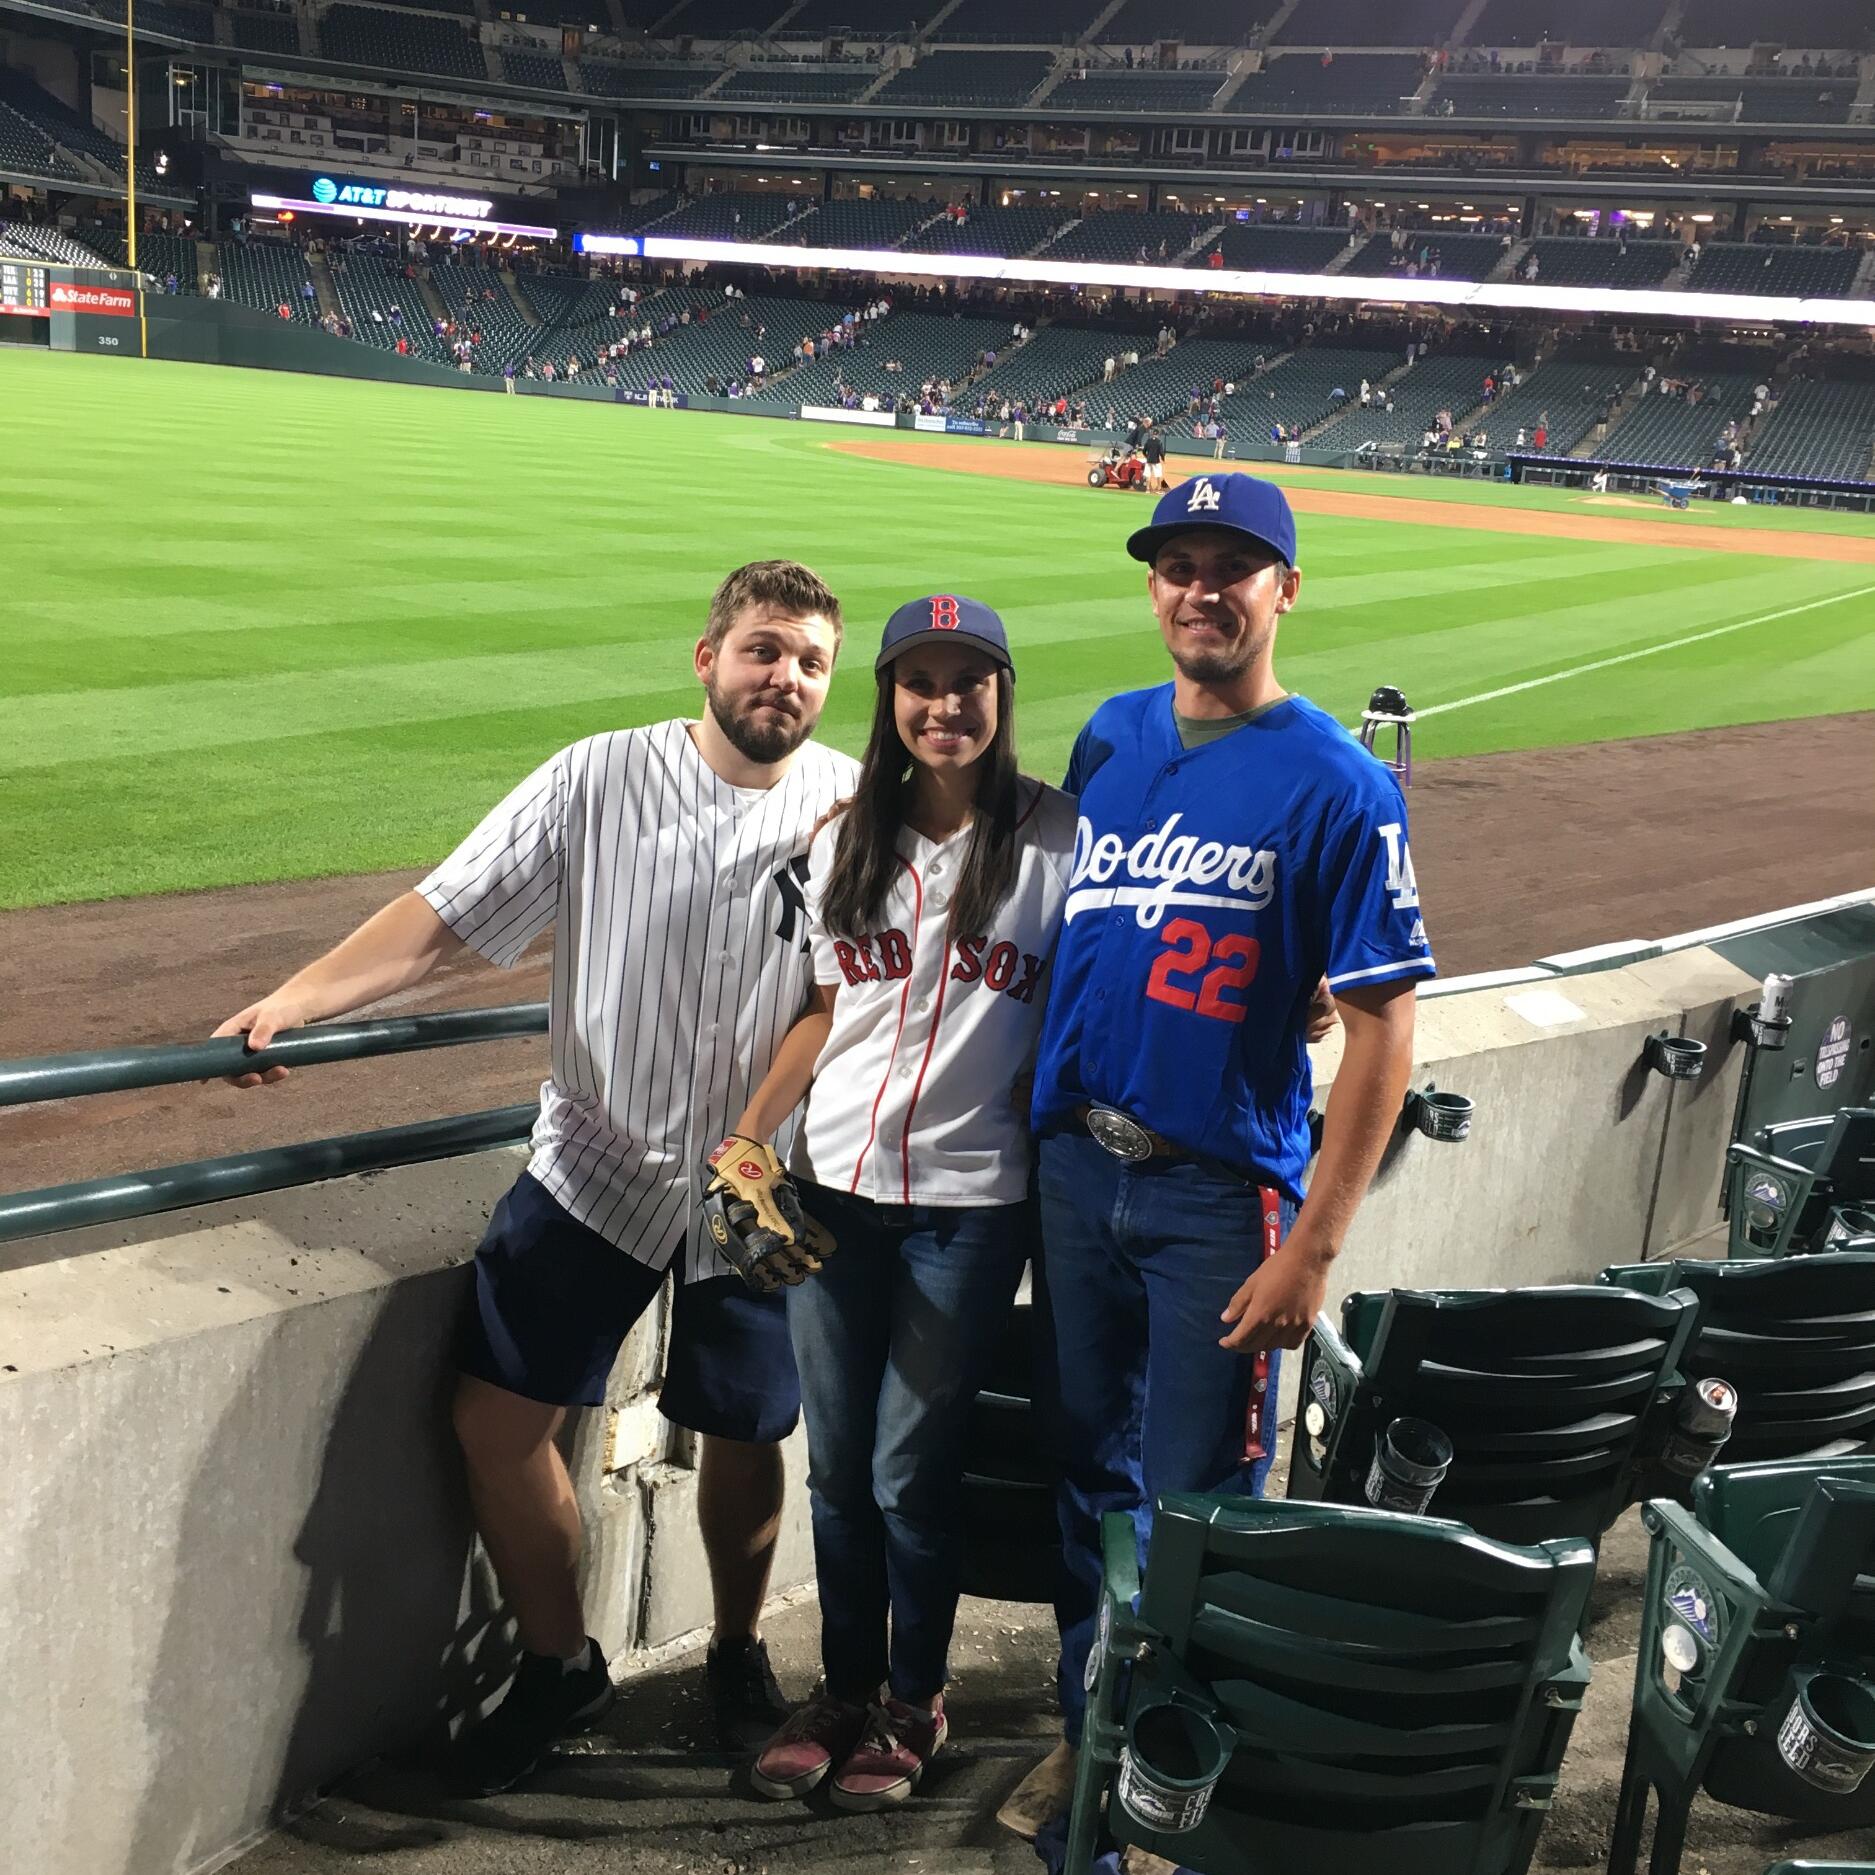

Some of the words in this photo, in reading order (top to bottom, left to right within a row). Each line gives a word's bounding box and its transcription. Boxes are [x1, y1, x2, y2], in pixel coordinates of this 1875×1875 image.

[339, 185, 387, 205] AT&T
[66, 289, 100, 305] State
[99, 292, 132, 308] Farm
[98, 336, 119, 346] 350
[1187, 477, 1221, 513] LA
[928, 596, 960, 630] B
[1064, 812, 1278, 929] Dodgers
[833, 928, 914, 987] RED
[951, 932, 1048, 1004] SOX
[1146, 917, 1261, 1024] 22
[1830, 1021, 1846, 1042] NO
[1817, 1058, 1834, 1074] ONTO
[1834, 1053, 1847, 1068] THE
[1820, 1068, 1839, 1087] FIELD
